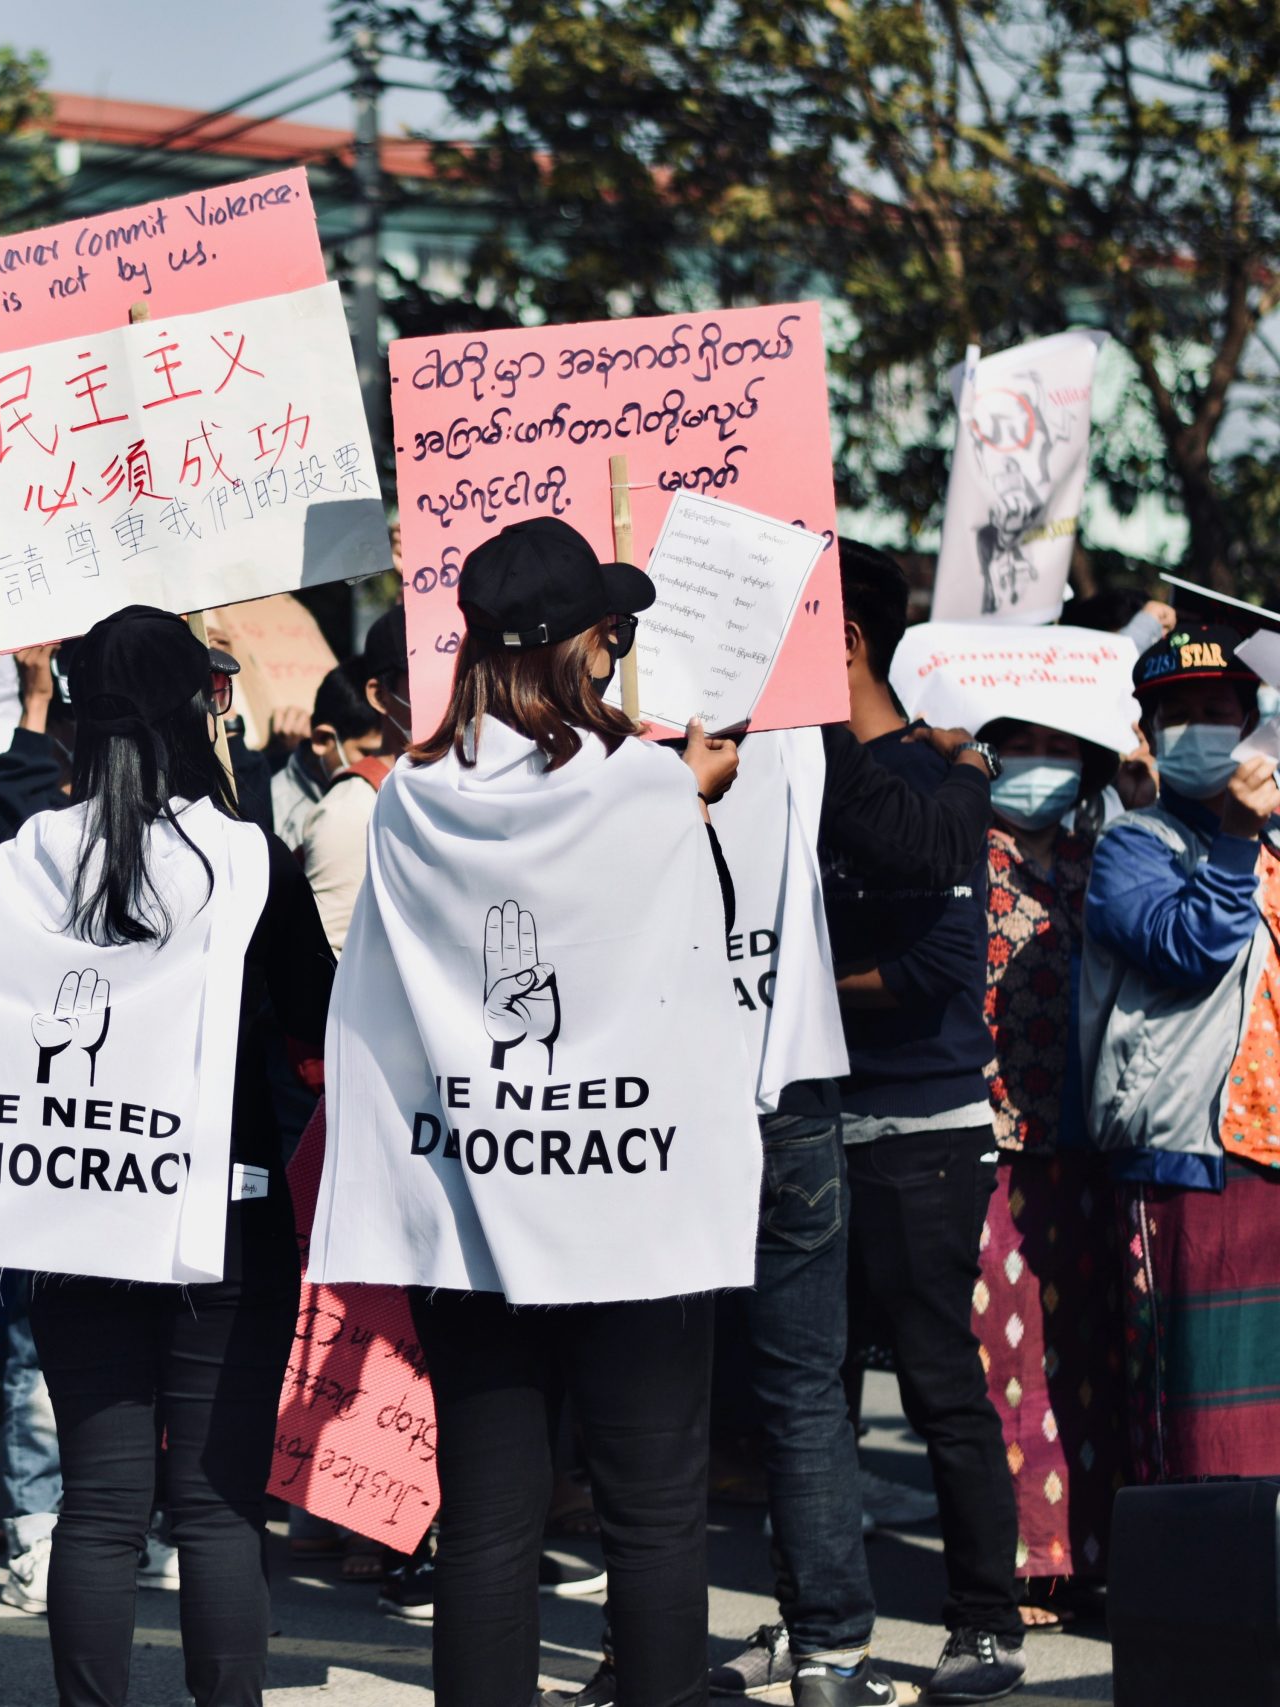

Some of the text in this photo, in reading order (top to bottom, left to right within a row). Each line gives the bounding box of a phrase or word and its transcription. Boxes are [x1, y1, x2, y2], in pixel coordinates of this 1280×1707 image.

[2, 291, 23, 313] is
[49, 265, 91, 299] not
[117, 256, 152, 295] by
[1180, 642, 1228, 668] STAR
[41, 1095, 182, 1139] NEED
[436, 1076, 650, 1112] E NEED
[377, 1392, 438, 1462] Stop
[318, 1449, 424, 1525] Justice
